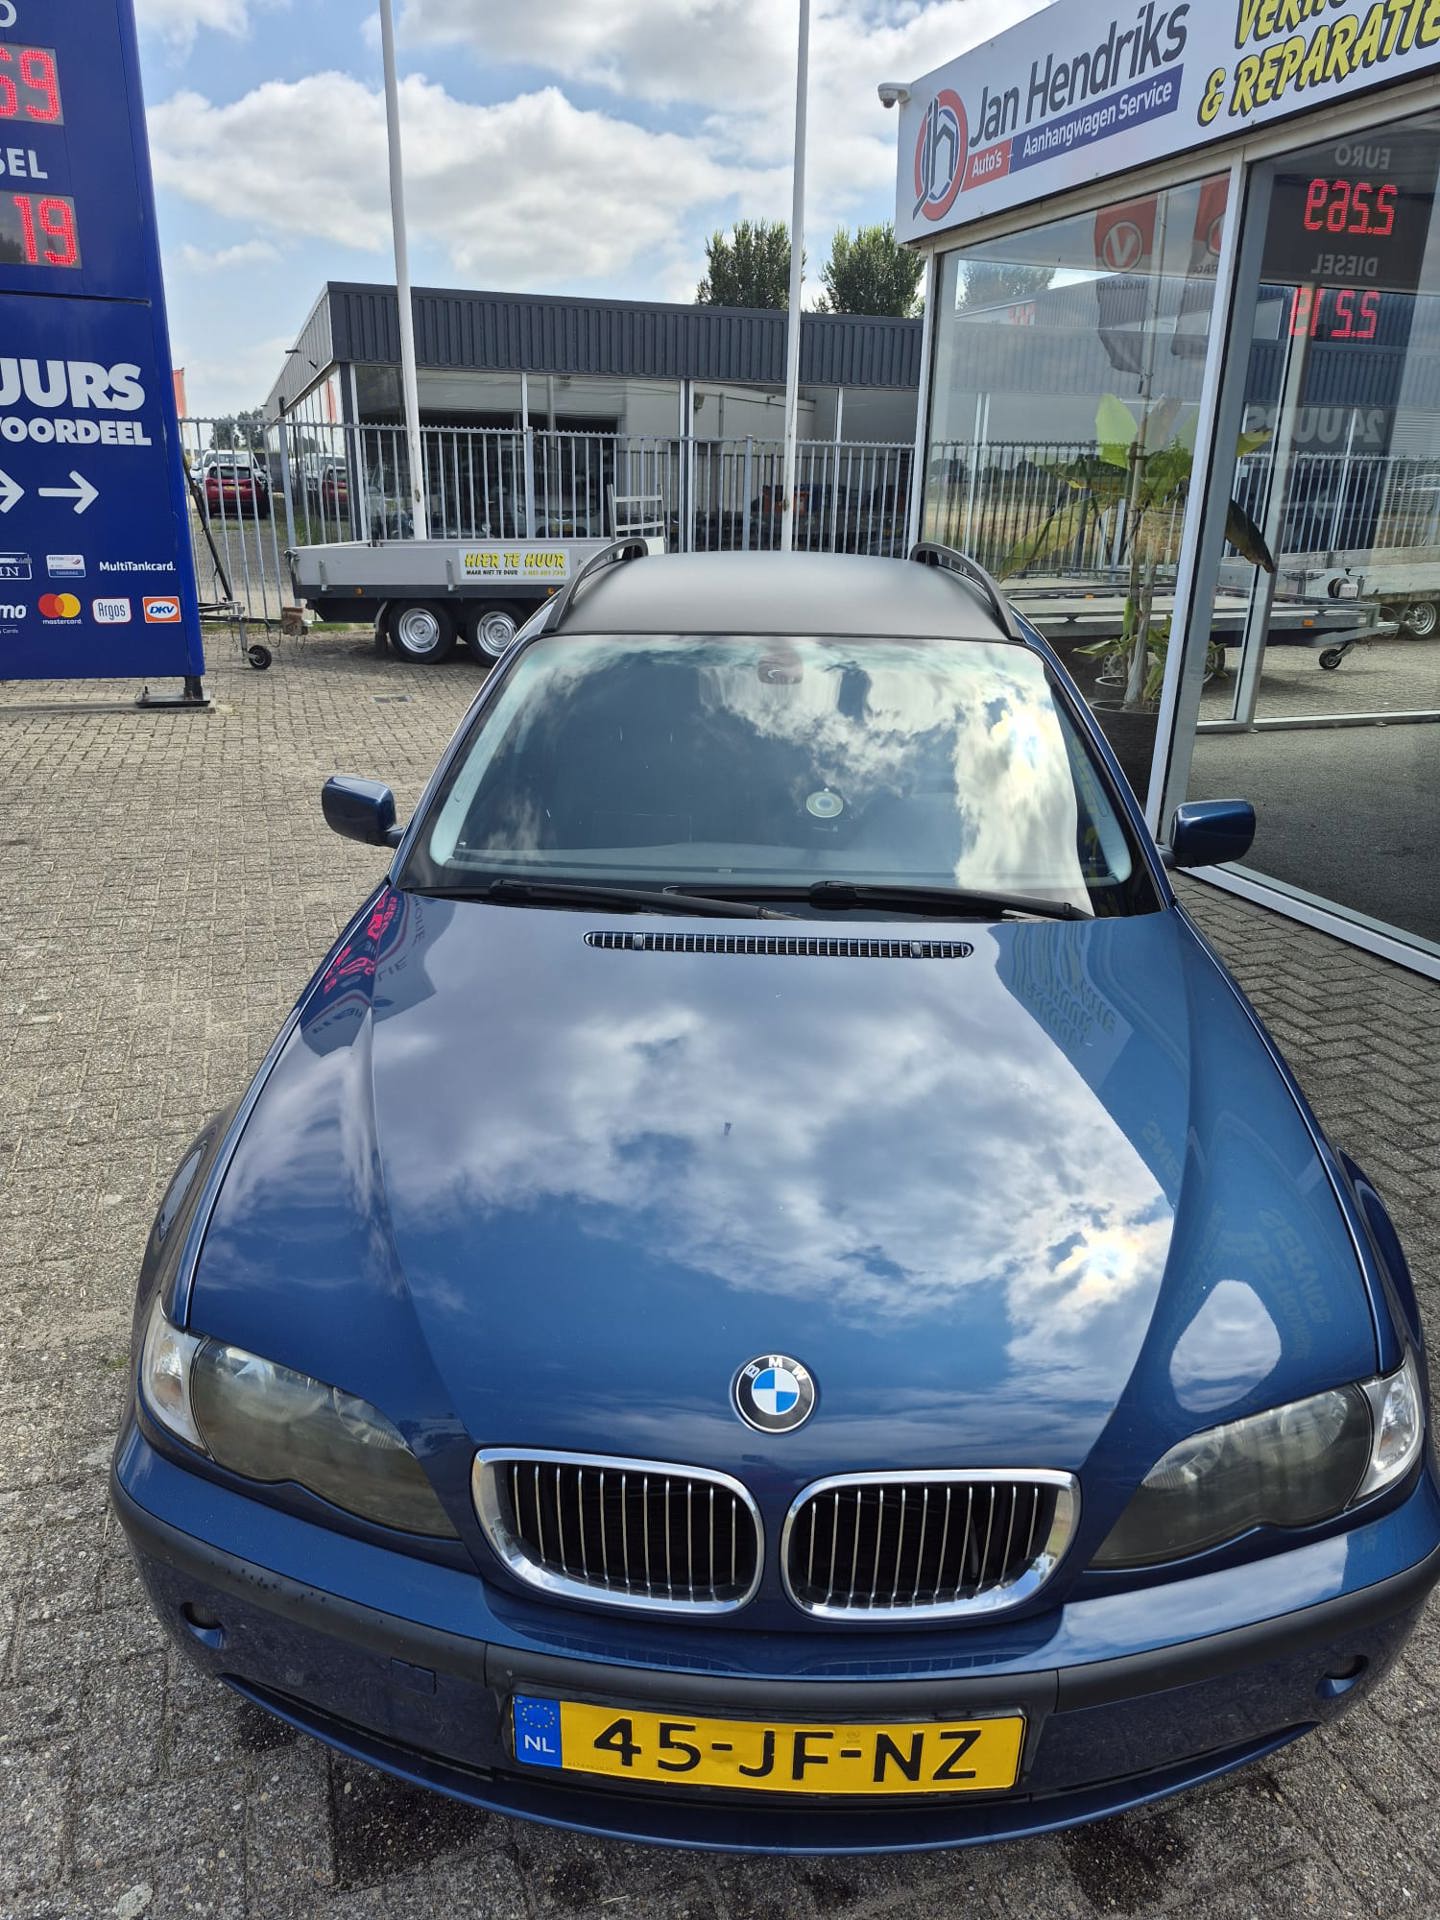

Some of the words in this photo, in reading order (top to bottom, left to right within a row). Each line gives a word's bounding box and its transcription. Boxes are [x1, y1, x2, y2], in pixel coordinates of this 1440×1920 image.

[969, 86, 1020, 147] Jan
[1025, 3, 1191, 125] Hendriks
[1198, 67, 1227, 127] &
[971, 150, 1002, 178] Auto's
[1023, 106, 1116, 158] Aanhangwagen
[1118, 80, 1172, 120] Service
[0, 147, 48, 179] EL
[0, 416, 152, 446] OORDEEL
[465, 553, 500, 568] HIER
[504, 553, 520, 568] TE
[525, 553, 566, 568] HUUR
[98, 602, 126, 621] Argos
[150, 605, 175, 614] DKV
[744, 1357, 808, 1381] BMW
[524, 1734, 556, 1753] NL
[593, 1717, 983, 1784] 45-JF-NZ
